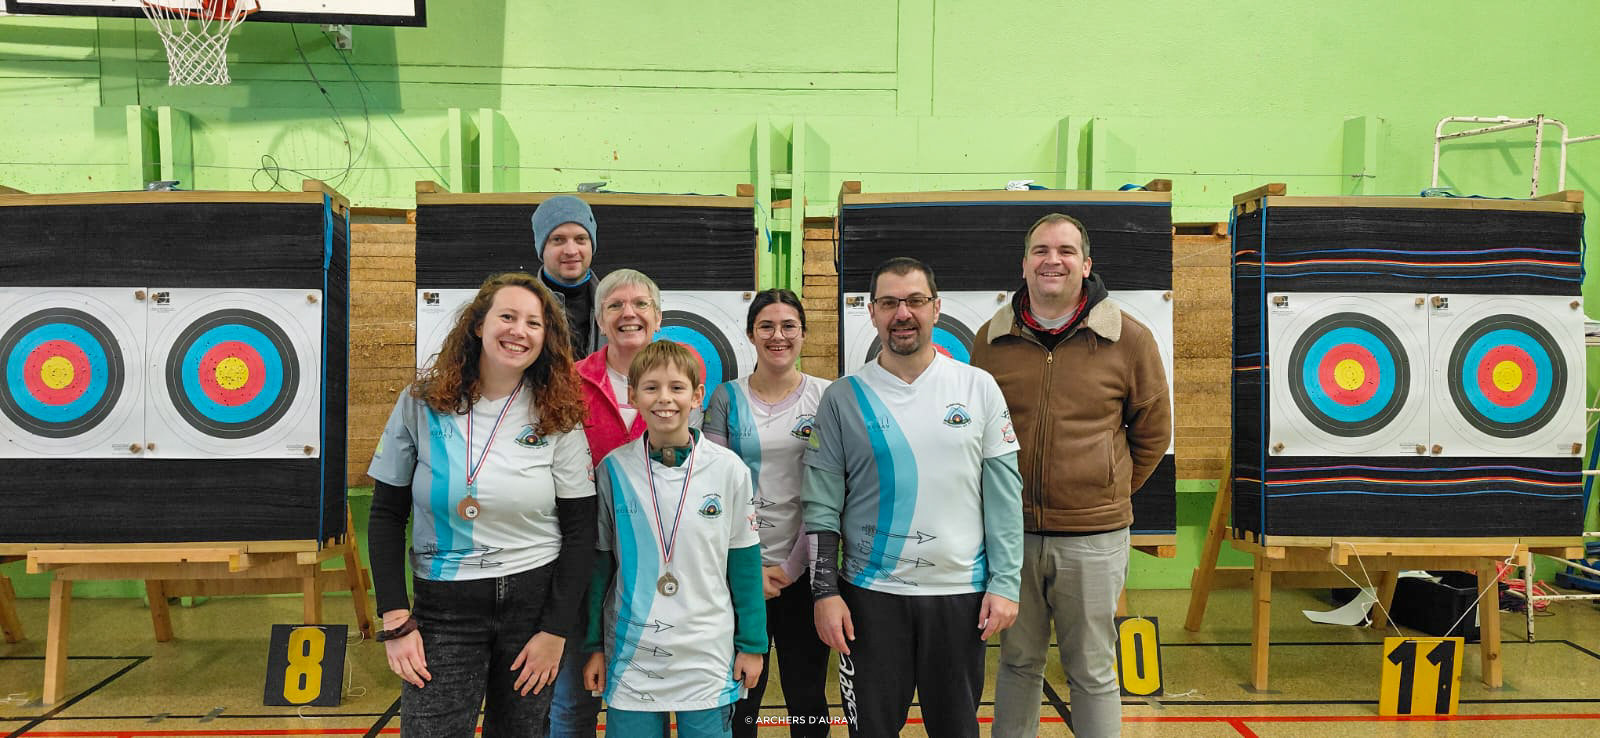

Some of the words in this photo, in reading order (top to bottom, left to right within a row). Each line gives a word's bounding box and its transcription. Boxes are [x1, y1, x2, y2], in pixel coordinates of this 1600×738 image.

[283, 627, 326, 704] 8
[1115, 617, 1160, 695] 0
[1387, 640, 1456, 714] 11
